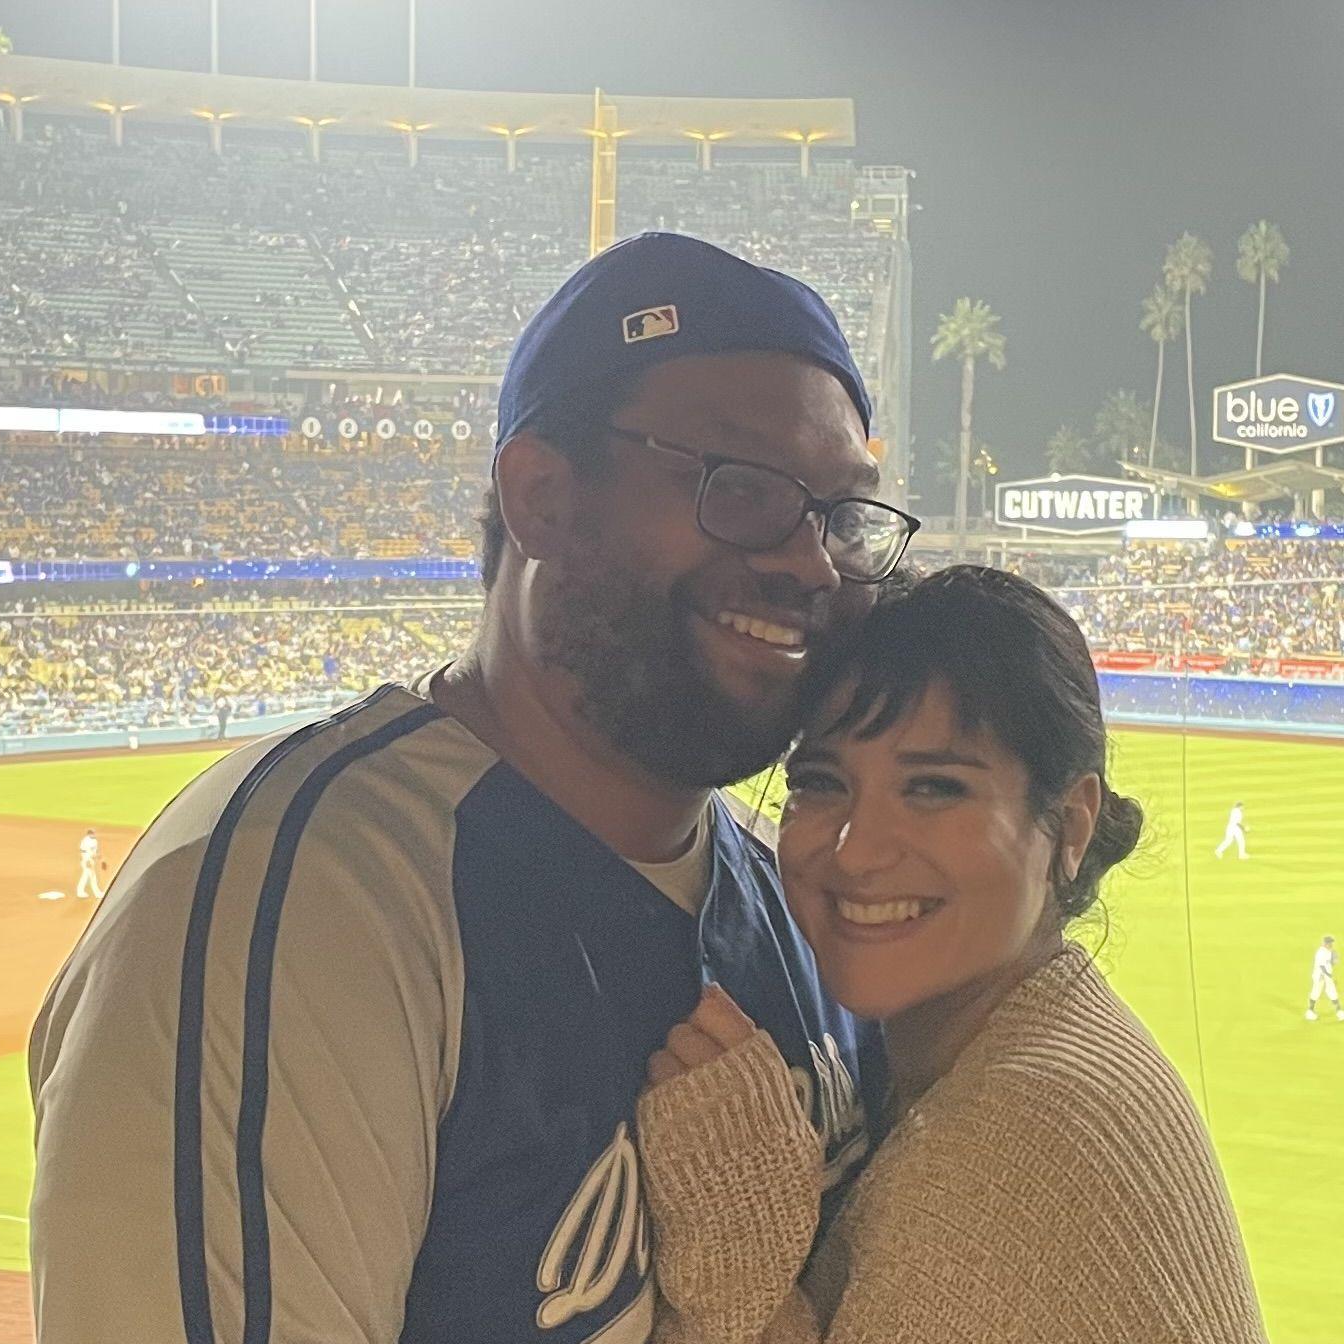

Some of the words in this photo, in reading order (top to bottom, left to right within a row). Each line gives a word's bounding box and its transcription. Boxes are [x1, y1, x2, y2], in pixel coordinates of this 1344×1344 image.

[1226, 391, 1300, 423] blue
[1236, 423, 1308, 439] california
[1005, 490, 1144, 520] CUTWATER
